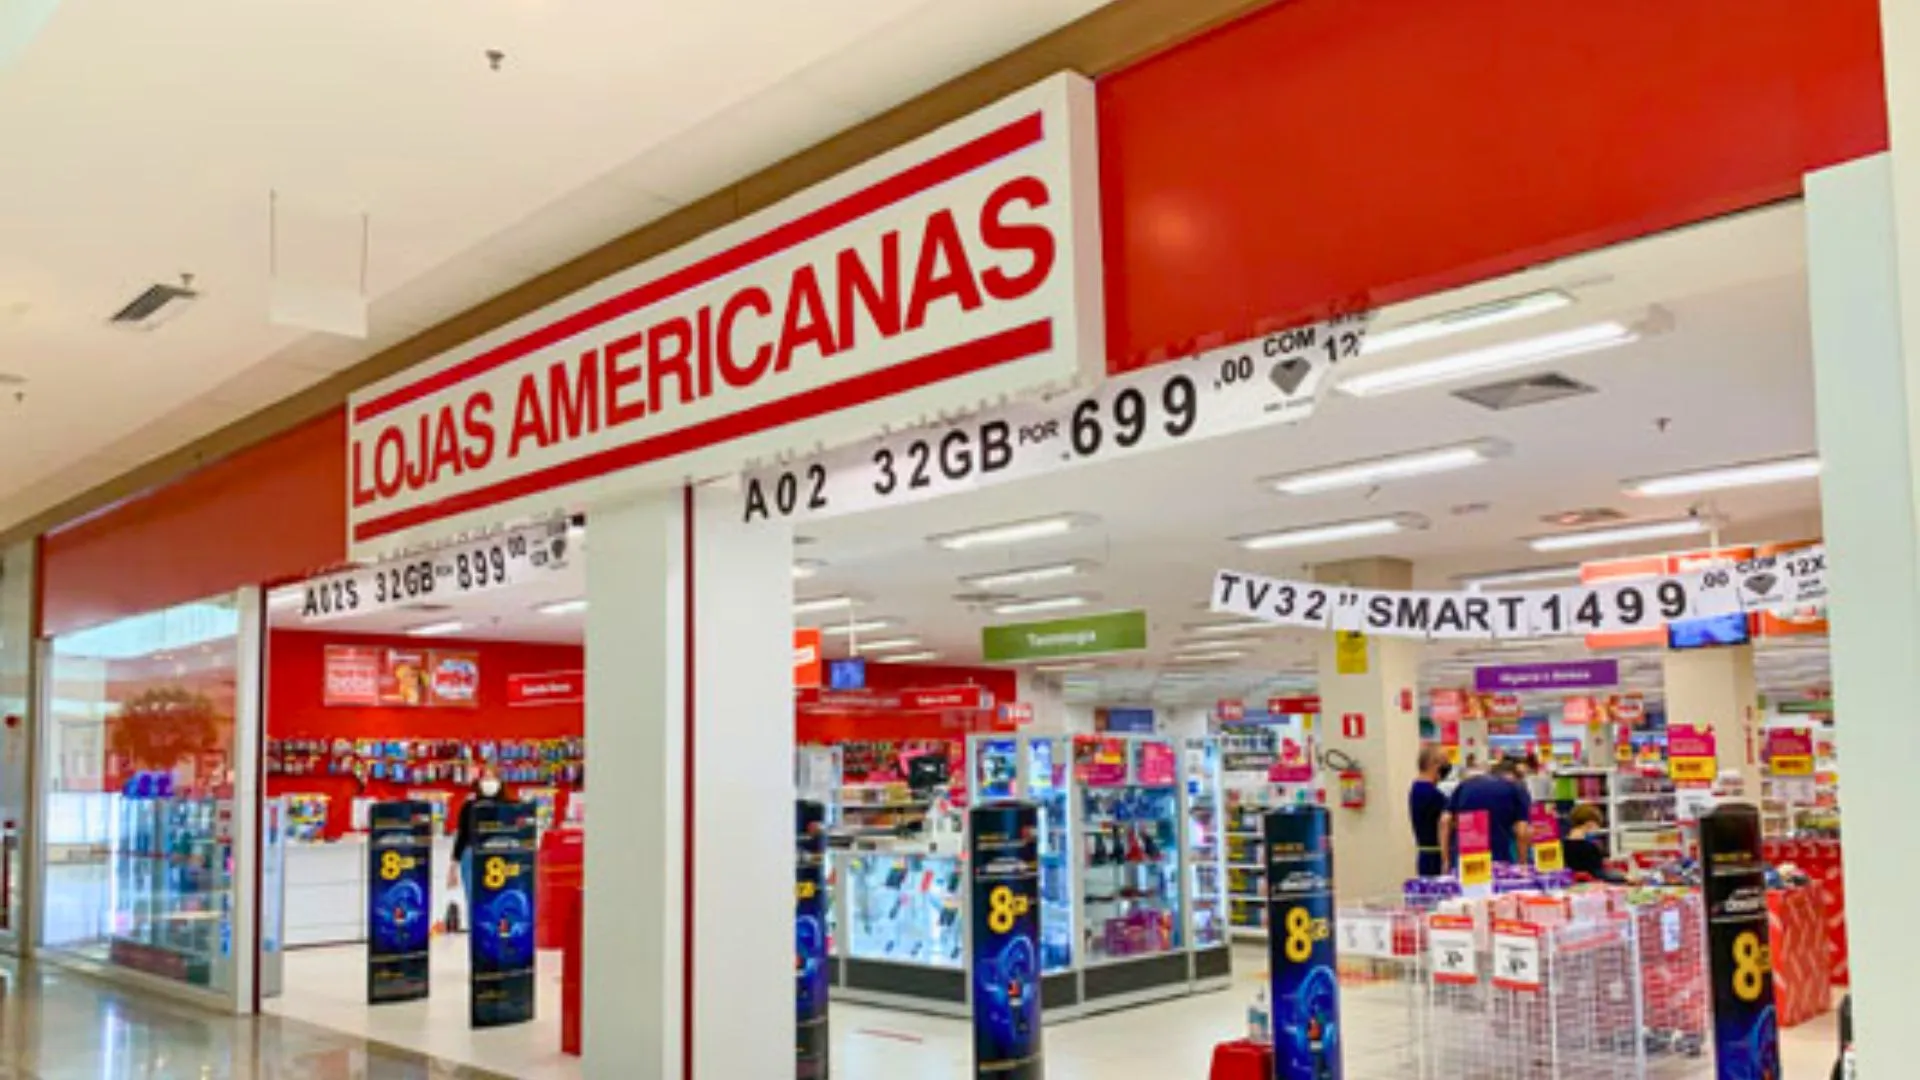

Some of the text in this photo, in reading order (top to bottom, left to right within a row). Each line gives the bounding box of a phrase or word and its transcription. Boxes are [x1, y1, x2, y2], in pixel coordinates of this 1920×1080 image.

[351, 174, 1056, 509] LOJAS AMERICANAS
[1263, 327, 1317, 358] COM
[743, 463, 828, 523] A02
[872, 420, 1014, 496] 32GB
[1018, 419, 1060, 447] POR
[376, 561, 434, 603] 32GB
[456, 546, 506, 590] 899
[1367, 592, 1525, 633] SMART
